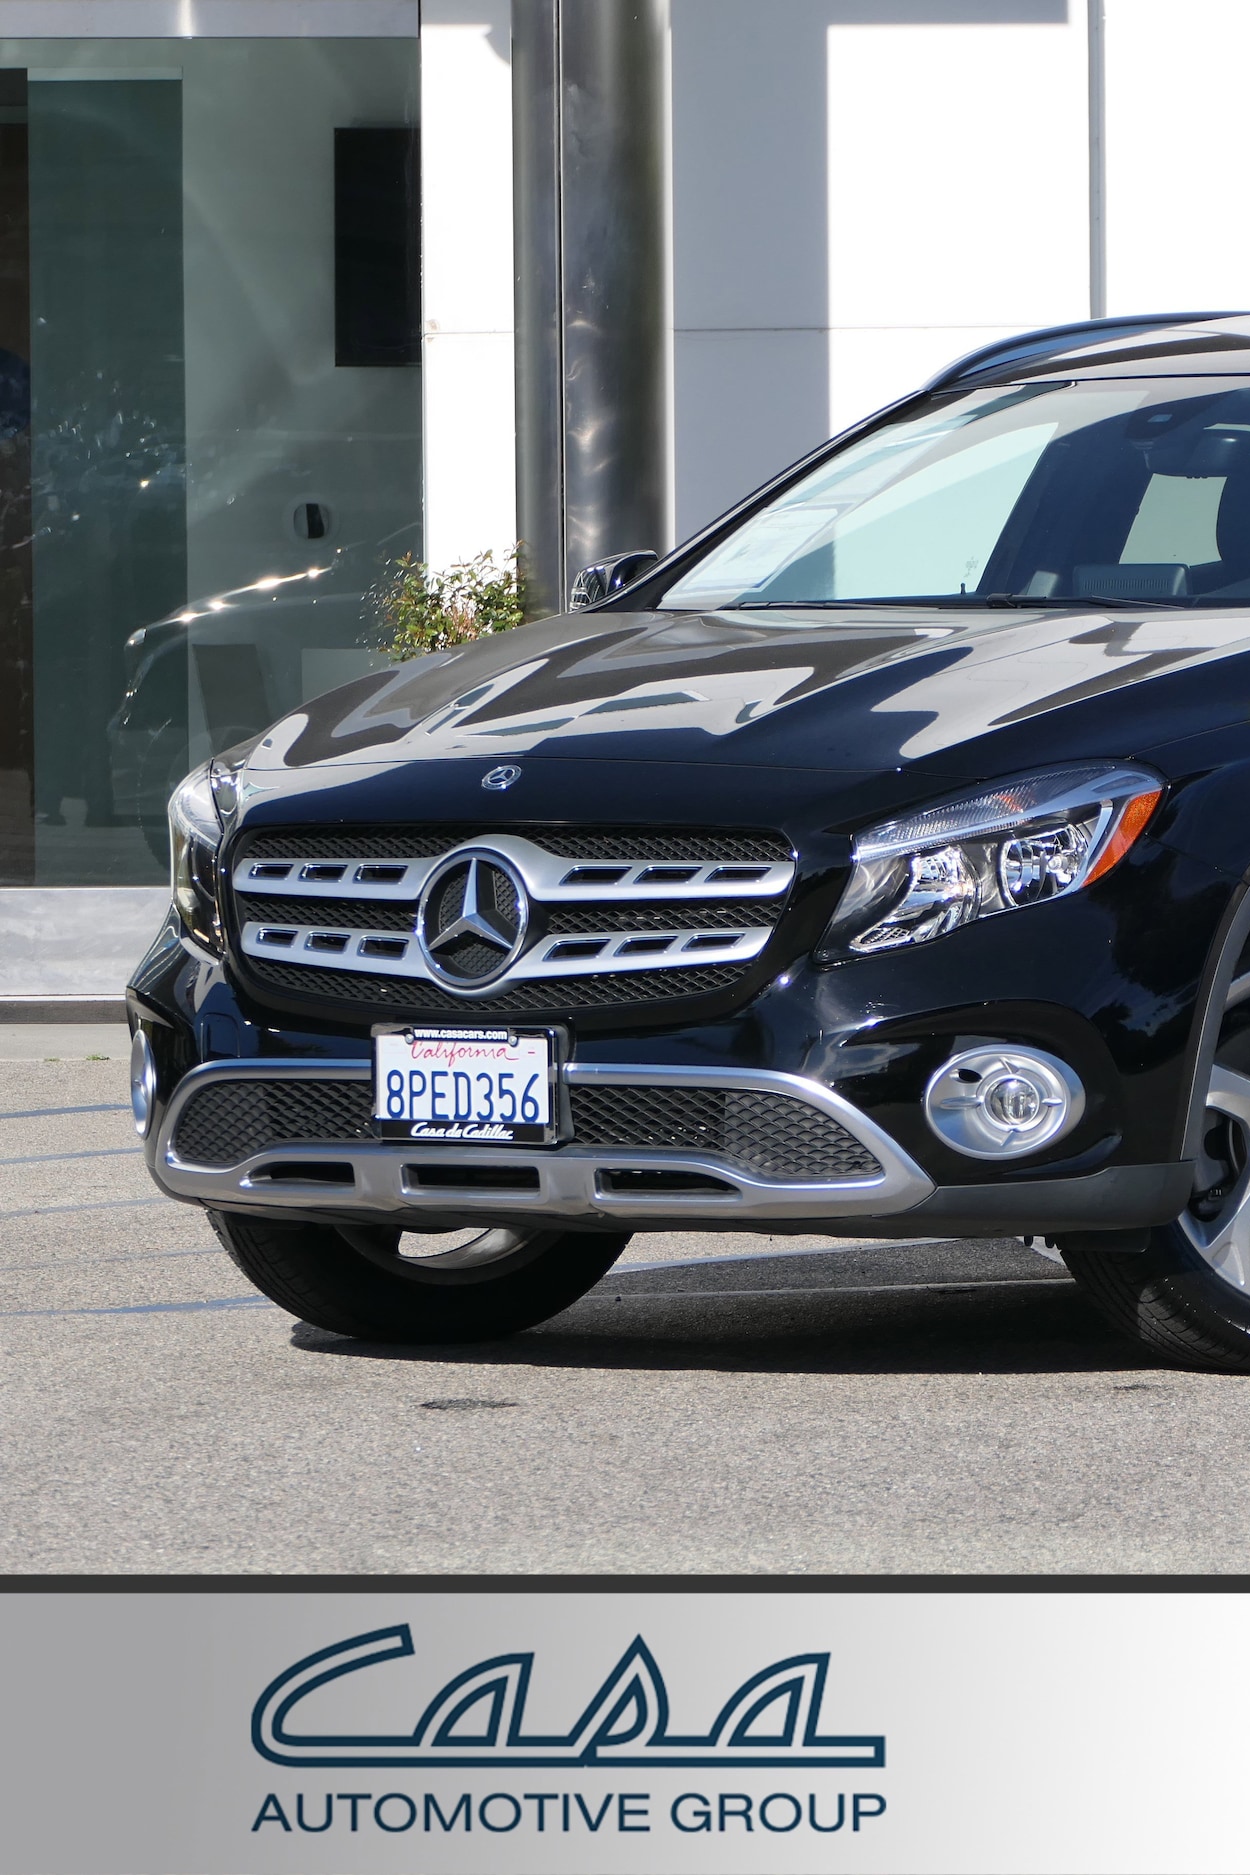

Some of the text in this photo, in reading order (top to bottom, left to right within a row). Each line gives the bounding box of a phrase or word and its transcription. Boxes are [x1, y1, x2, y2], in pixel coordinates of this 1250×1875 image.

[414, 1027, 508, 1041] www.casacars.com
[410, 1040, 519, 1067] California
[386, 1069, 540, 1123] 8PED356
[410, 1121, 514, 1140] Casa de Cadillac
